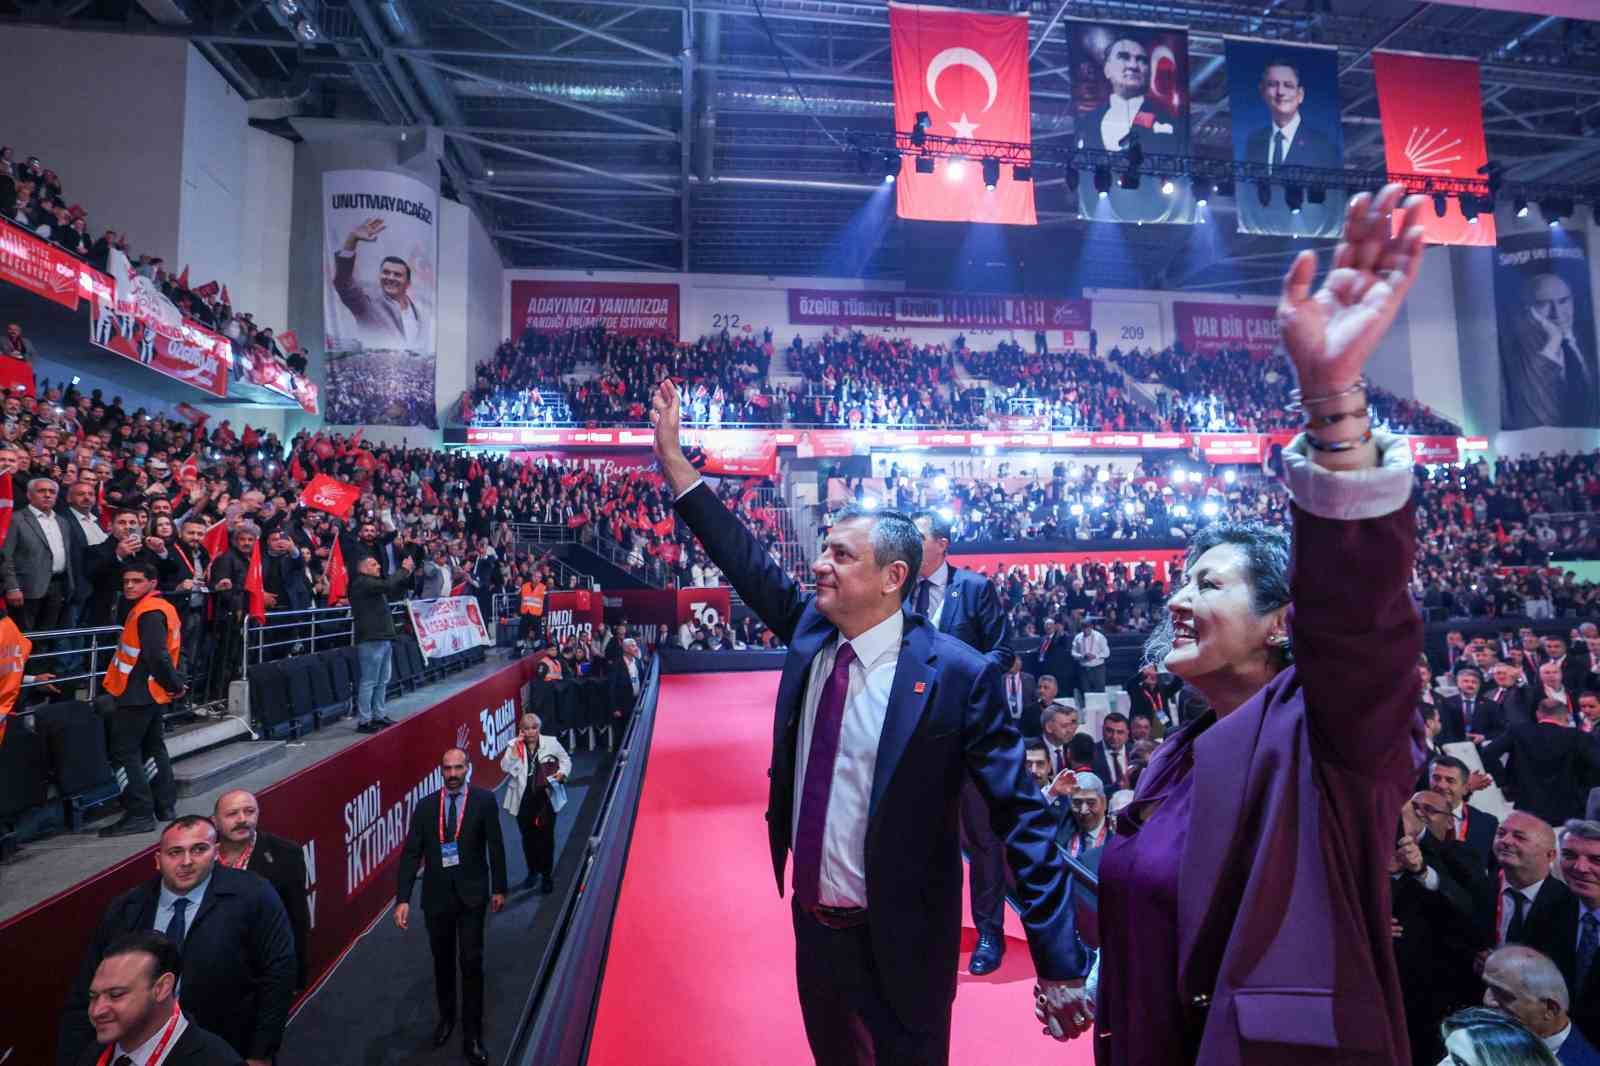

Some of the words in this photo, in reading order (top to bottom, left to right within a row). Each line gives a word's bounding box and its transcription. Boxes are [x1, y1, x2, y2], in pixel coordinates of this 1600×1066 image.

[528, 298, 595, 314] ADAYIMIZI
[599, 299, 669, 314] YANIMIZDA
[800, 297, 840, 316] ÖZGÜR
[712, 313, 740, 328] 212
[1192, 316, 1218, 337] VAR
[1221, 314, 1244, 337] BİR
[1121, 326, 1145, 340] 209
[345, 780, 381, 845] ŞİMDİ
[347, 800, 403, 895] İKTİDAR
